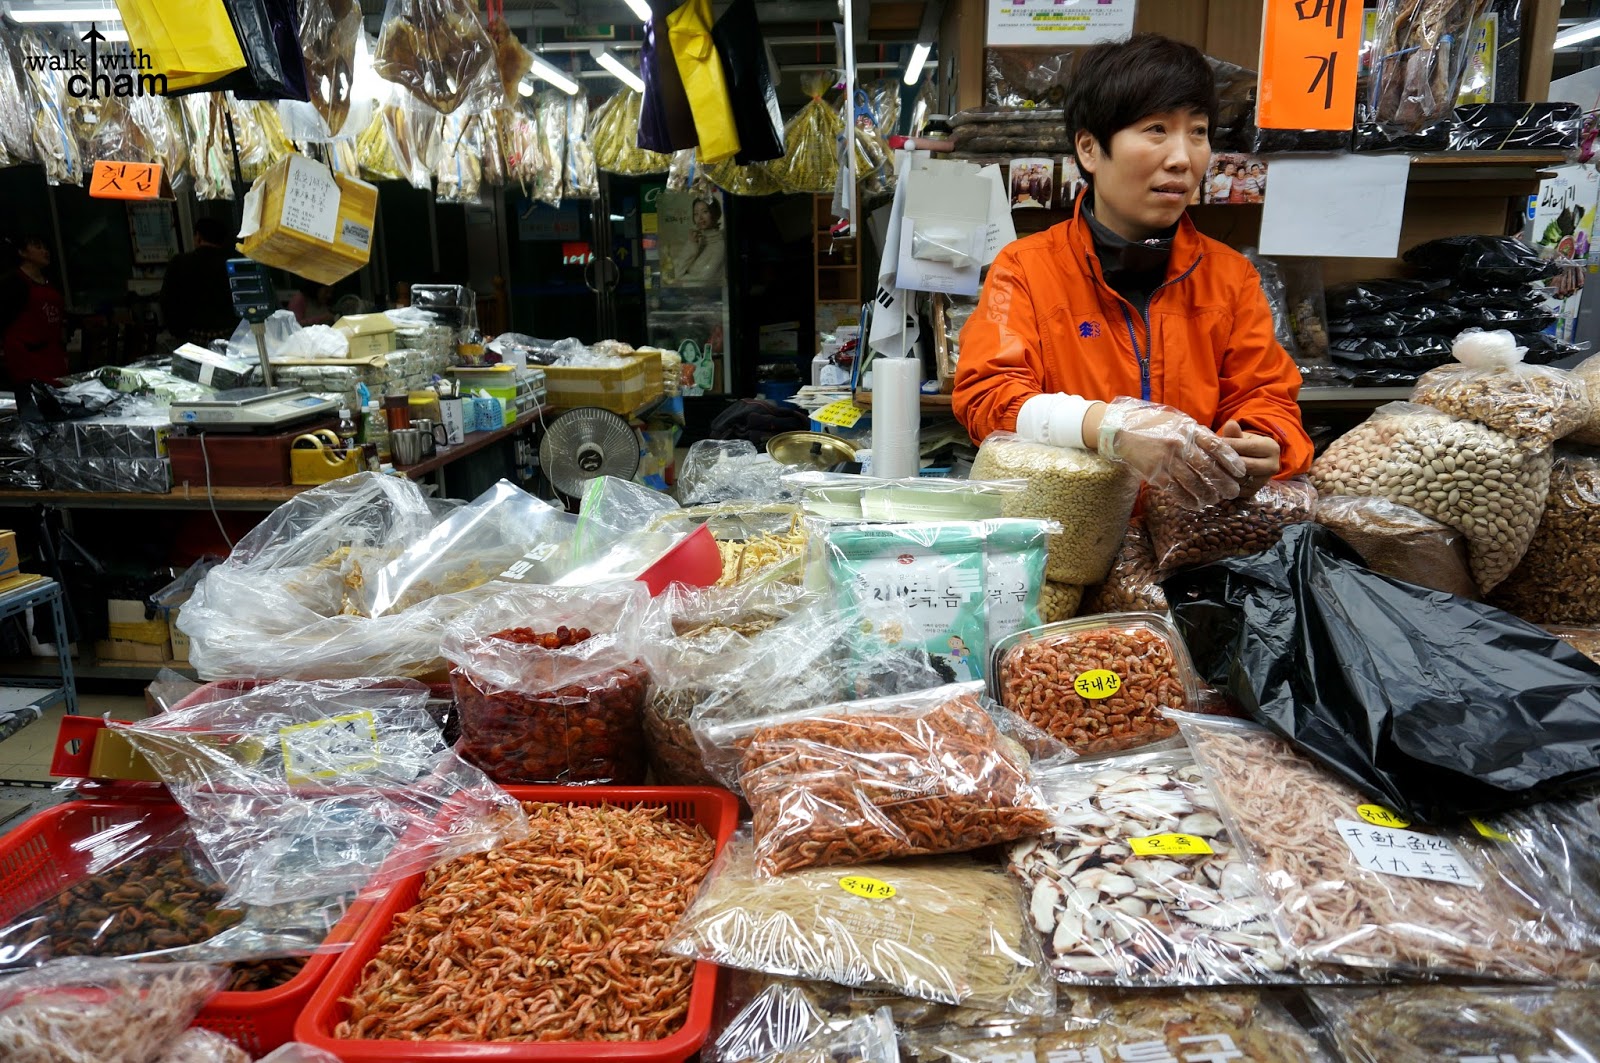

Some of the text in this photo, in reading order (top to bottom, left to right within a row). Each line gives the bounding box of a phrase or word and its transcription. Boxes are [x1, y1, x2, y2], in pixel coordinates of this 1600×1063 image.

[1541, 184, 1576, 210] 과메기
[1077, 675, 1118, 693] 국내산
[843, 878, 892, 897] 국내산
